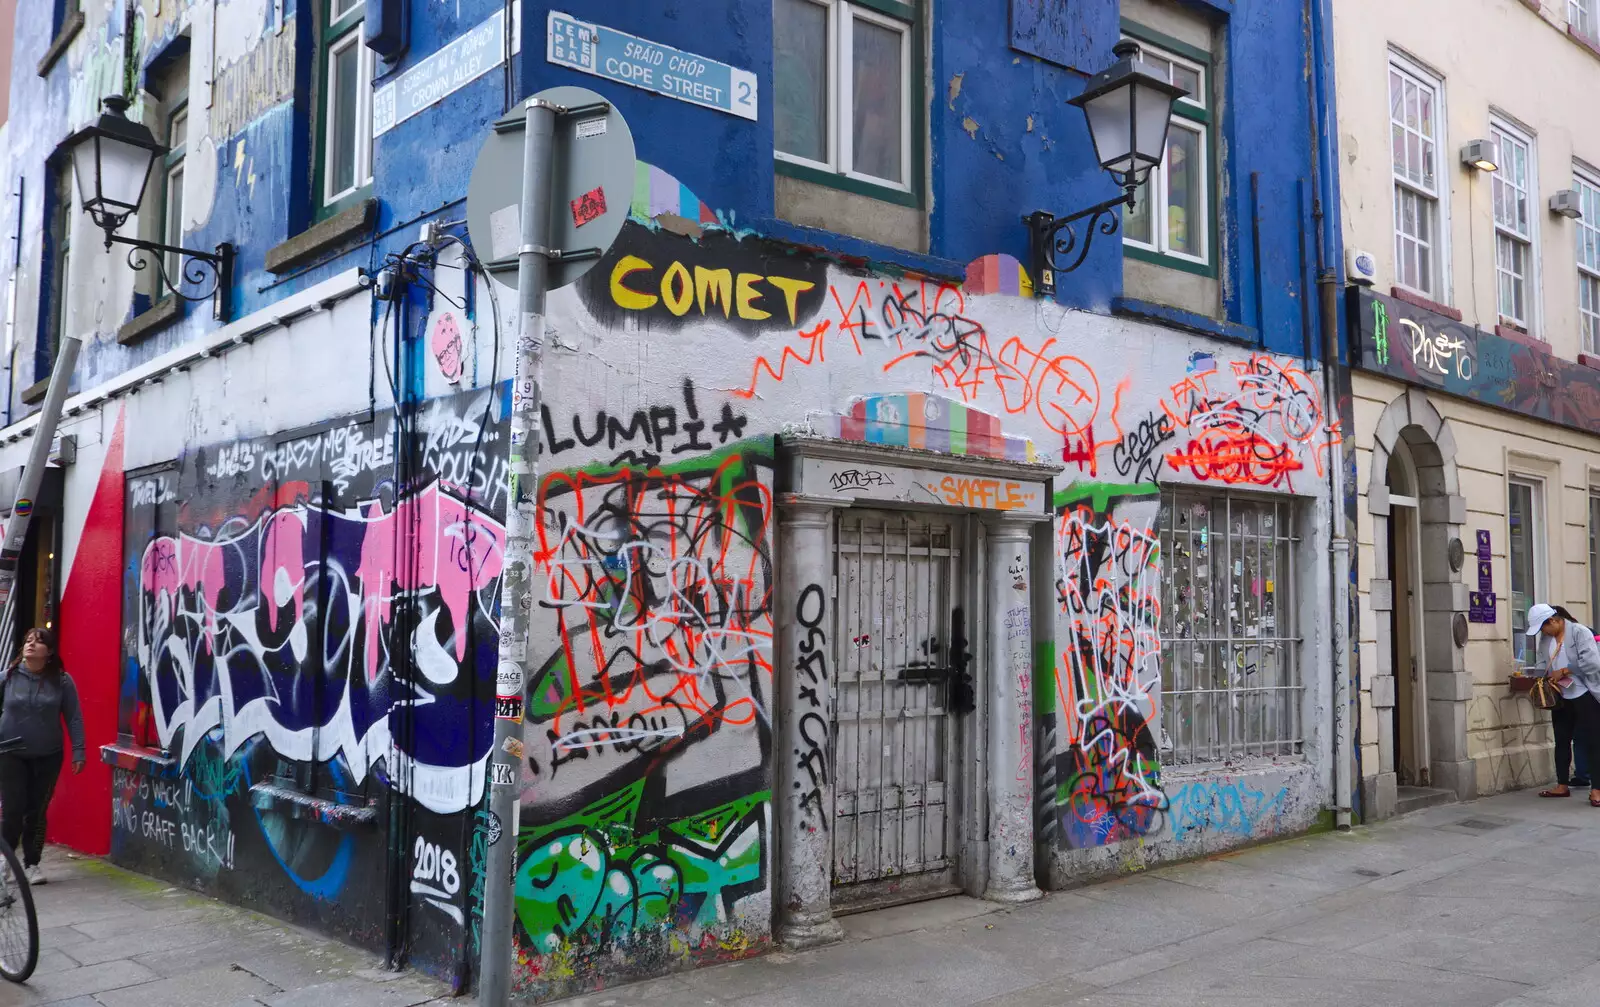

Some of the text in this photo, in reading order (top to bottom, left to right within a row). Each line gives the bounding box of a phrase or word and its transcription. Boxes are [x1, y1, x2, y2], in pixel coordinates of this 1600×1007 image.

[411, 54, 483, 107] CROWN ALLEY
[605, 57, 722, 104] COPE STREET
[624, 41, 705, 78] SRÁID CHÓP
[737, 81, 752, 106] 2
[610, 254, 816, 328] COMET
[141, 811, 176, 850] GRAFF
[181, 822, 225, 868] BACK
[413, 834, 461, 892] 2018
